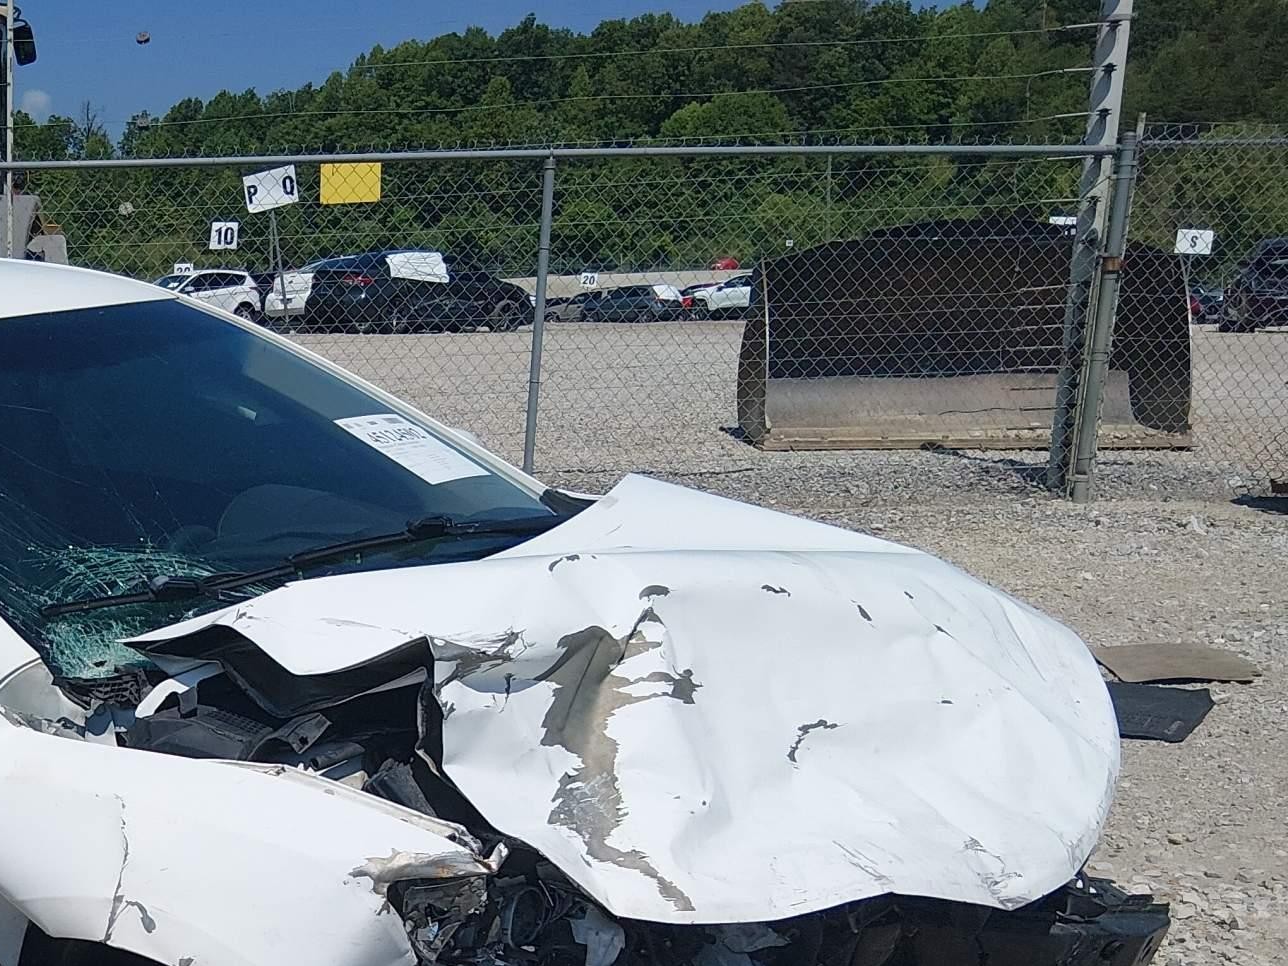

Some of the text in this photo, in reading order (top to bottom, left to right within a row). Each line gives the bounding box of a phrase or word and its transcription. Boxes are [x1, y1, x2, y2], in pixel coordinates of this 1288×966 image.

[247, 175, 295, 205] P Q
[215, 226, 235, 246] 10
[1190, 235, 1199, 248] S
[582, 275, 596, 286] 20
